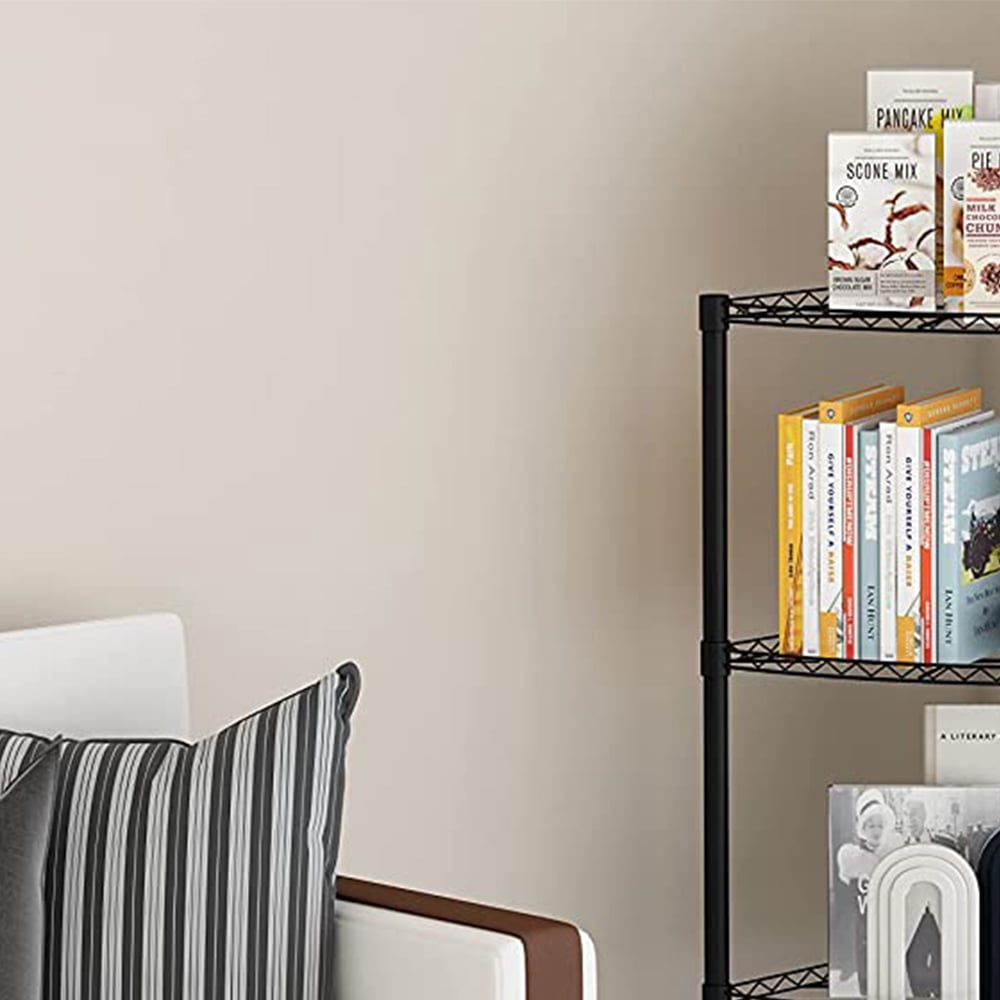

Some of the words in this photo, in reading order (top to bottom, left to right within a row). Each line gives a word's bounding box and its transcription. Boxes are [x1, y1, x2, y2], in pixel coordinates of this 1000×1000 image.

[876, 107, 934, 129] PANCAKE
[846, 162, 889, 180] SCONE
[894, 162, 918, 180] MIX
[971, 151, 992, 170] PIE
[966, 204, 996, 212] MILK
[827, 453, 836, 478] GIVE
[905, 457, 914, 482] GIVE
[864, 445, 878, 541] STEAM
[943, 448, 956, 544] STEAM
[827, 482, 836, 536] YOURSELF
[905, 486, 914, 541] YOURSELF
[866, 585, 876, 606] IAN
[944, 589, 954, 610] IAN
[866, 608, 876, 640] HUNT
[944, 612, 954, 645] HUNT
[950, 733, 997, 741] LITERARY
